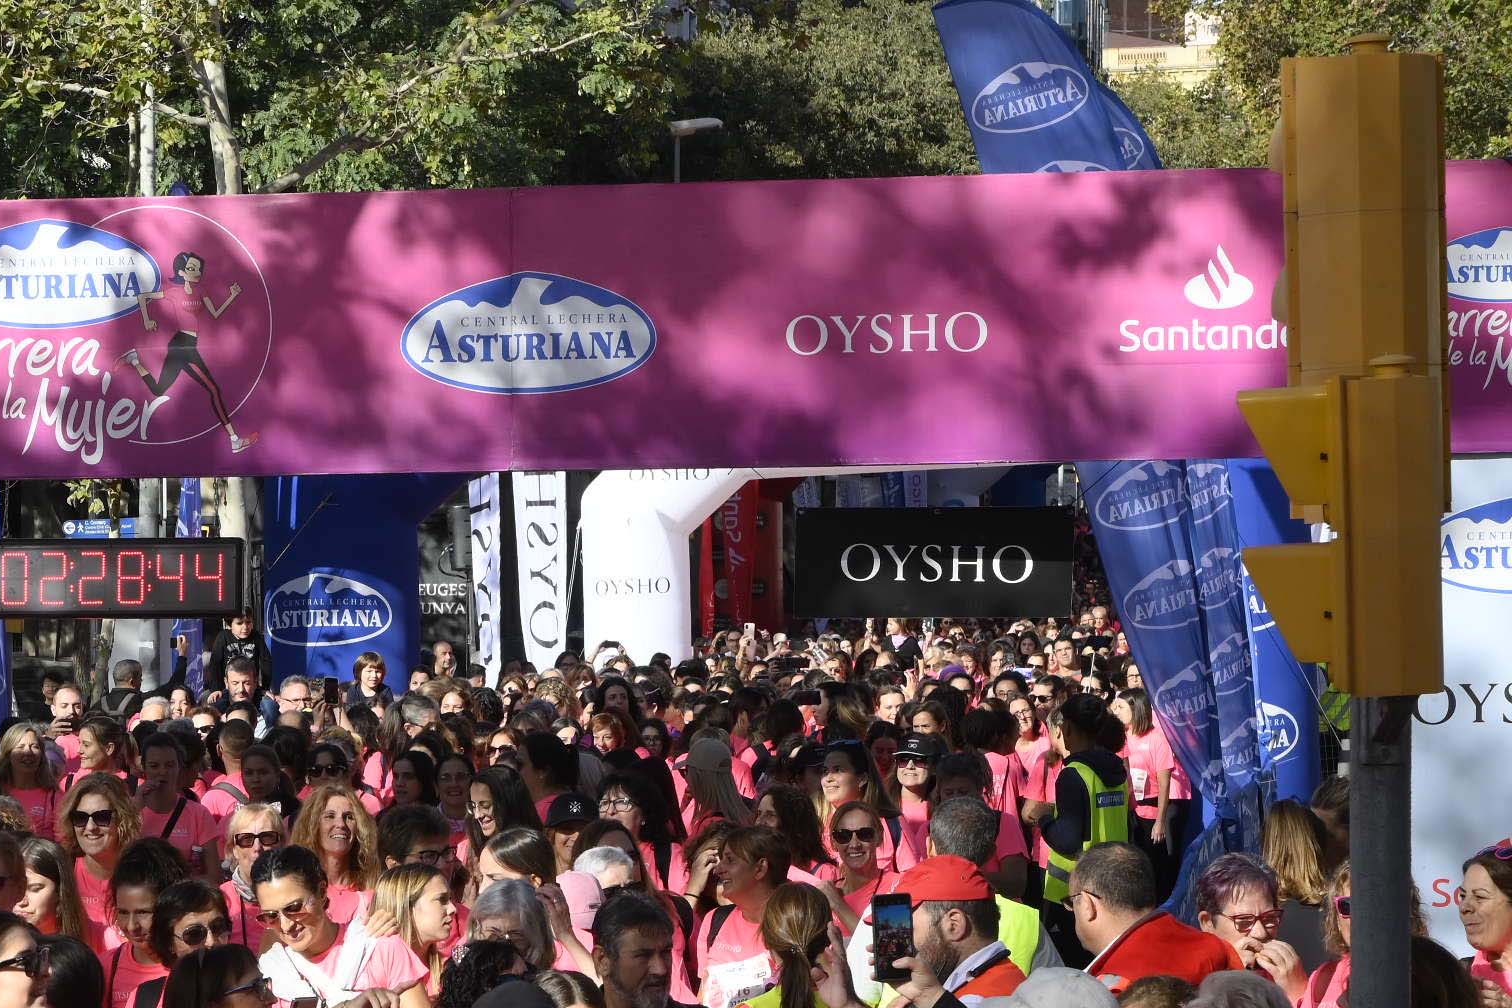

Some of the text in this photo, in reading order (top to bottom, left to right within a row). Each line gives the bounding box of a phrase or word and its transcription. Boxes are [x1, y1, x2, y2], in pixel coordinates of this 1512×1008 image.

[460, 312, 628, 328] CENTRAL LECHERA
[786, 311, 988, 356] OYSHO
[421, 319, 637, 363] ASTURIANA
[2, 380, 27, 421] la
[21, 370, 171, 465] Mujer
[1, 551, 223, 606] 02:28:44
[840, 543, 1034, 584] OYSHO
[418, 583, 466, 597] EUGES
[595, 576, 671, 596] OYSHO
[270, 602, 383, 630] ASTURIANA
[421, 602, 466, 615] UNYA
